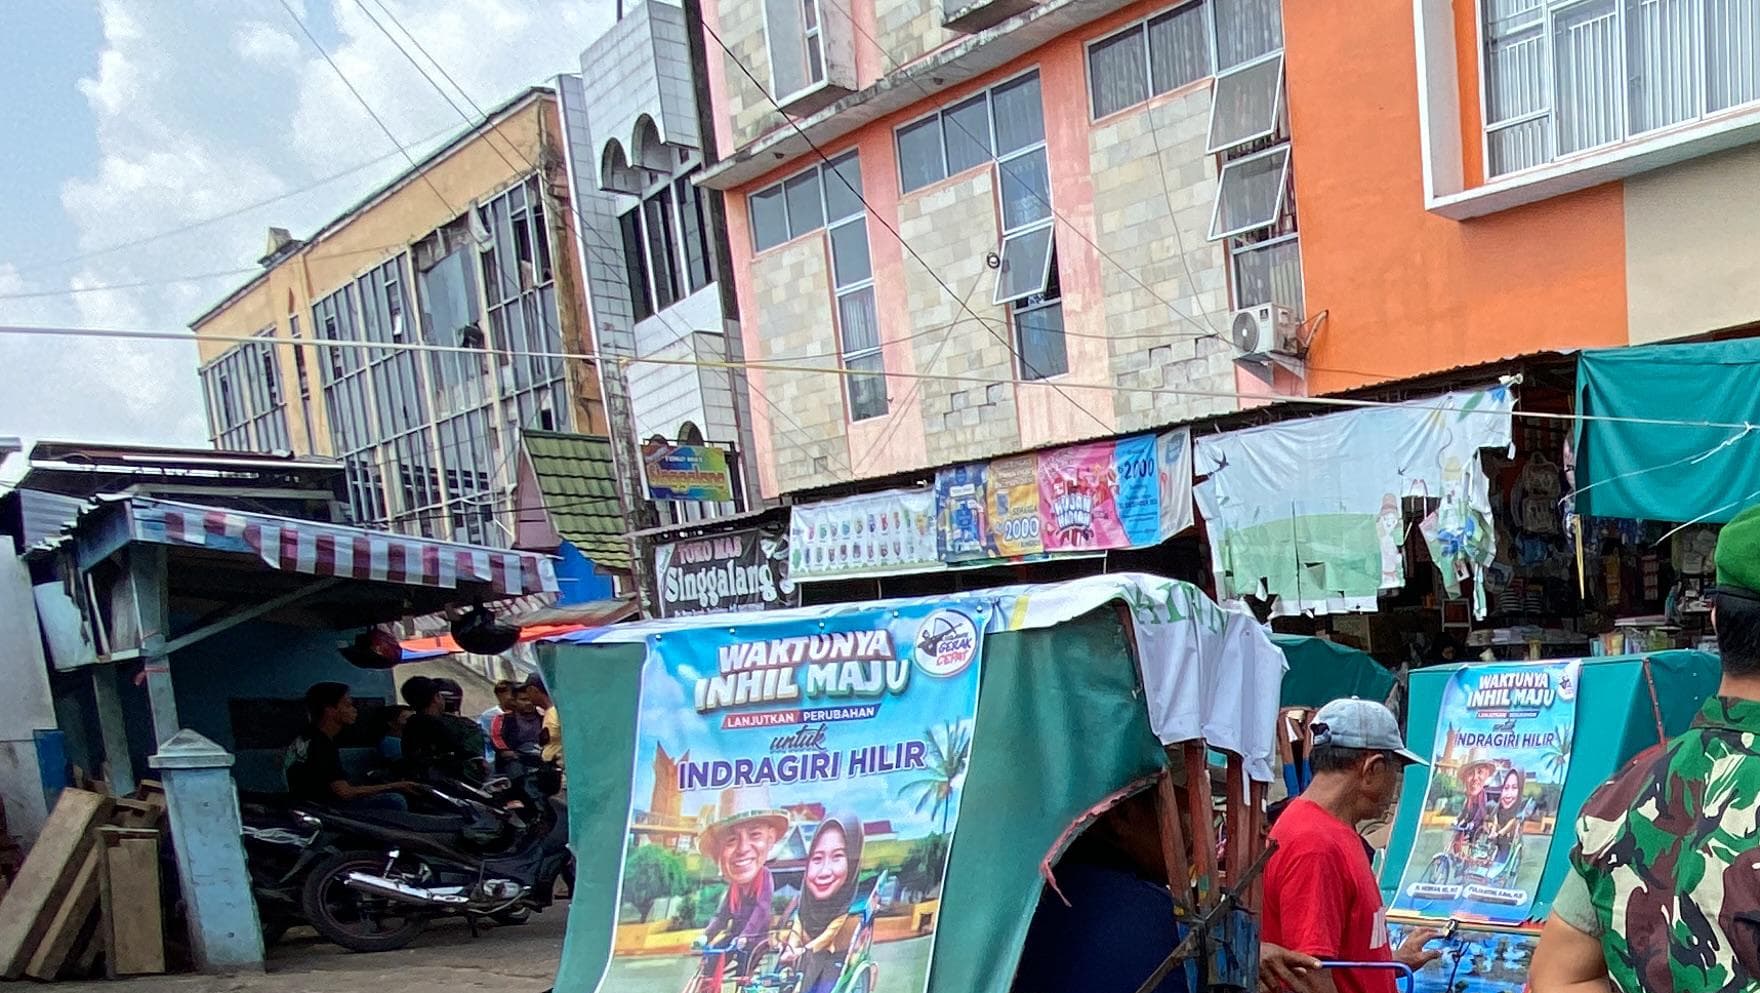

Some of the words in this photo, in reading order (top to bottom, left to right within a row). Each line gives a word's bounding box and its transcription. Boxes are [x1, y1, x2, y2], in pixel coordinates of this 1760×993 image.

[1005, 516, 1040, 541] 2000
[664, 559, 777, 607] Singgalang
[718, 628, 895, 674] WAKTUNYA
[694, 666, 799, 711] INHIL
[806, 658, 912, 698] MAJU
[1480, 672, 1550, 691] WAKTUNYA
[1467, 689, 1511, 708] INHIL
[1512, 689, 1557, 708] MAJU
[726, 712, 795, 728] LANJUTKAN
[802, 706, 876, 723] PERUBAHAN
[769, 723, 828, 751] untuk
[1455, 733, 1520, 748] INDRAGIRI
[1522, 732, 1556, 748] HILIR
[679, 751, 840, 790] INDRAGIRI
[848, 740, 926, 776] HILIR
